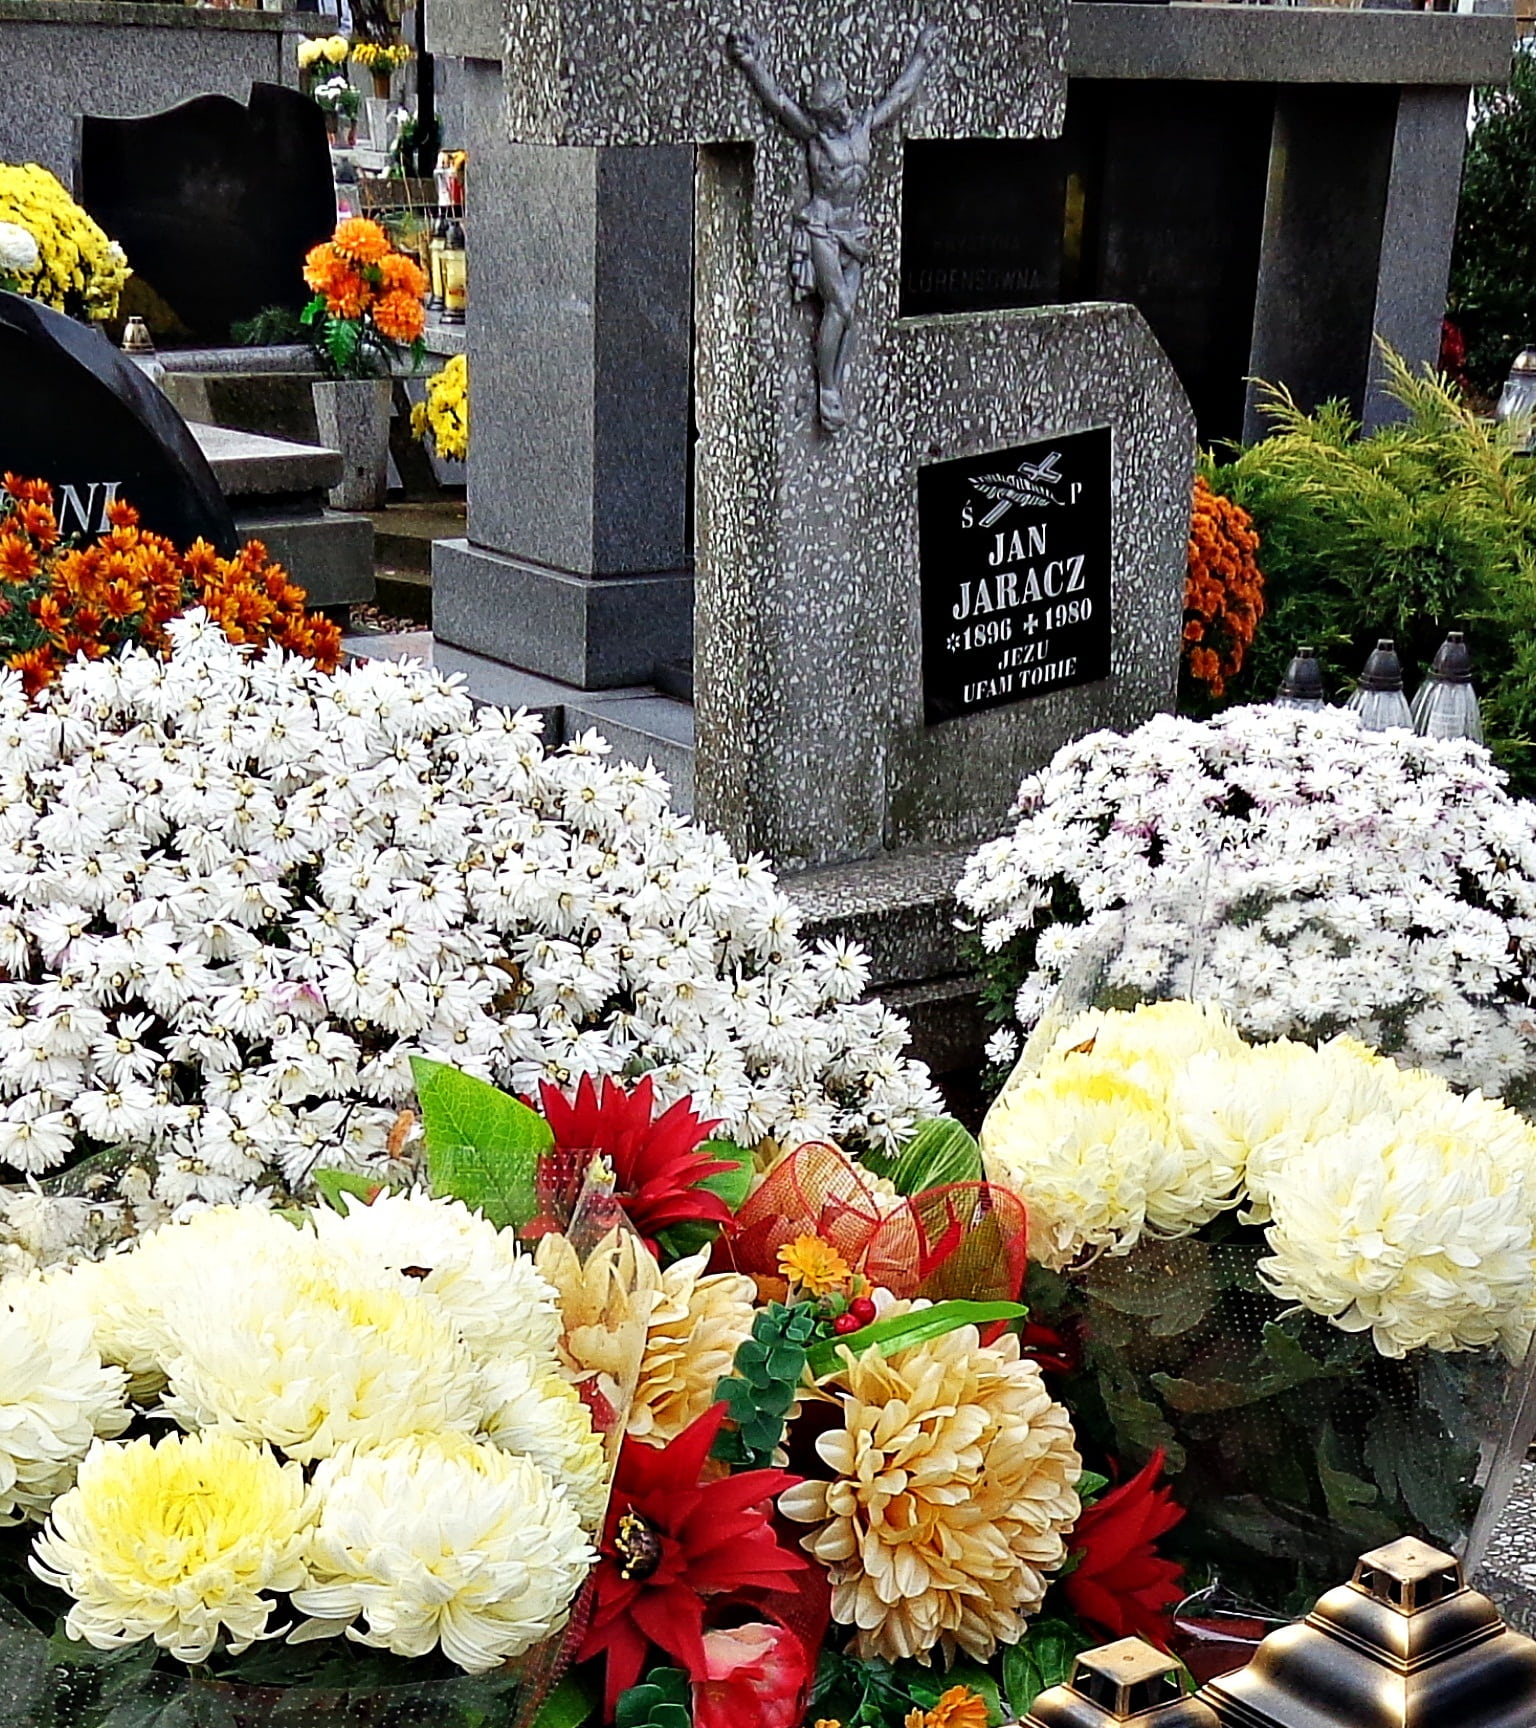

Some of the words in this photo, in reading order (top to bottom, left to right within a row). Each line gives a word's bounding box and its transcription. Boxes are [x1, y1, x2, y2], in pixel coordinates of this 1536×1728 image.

[988, 523, 1047, 567] JAN
[952, 554, 1085, 620] JARACZ
[998, 639, 1049, 671] JEZU
[964, 674, 1012, 704] UFAM
[1019, 656, 1078, 689] TOBIE
